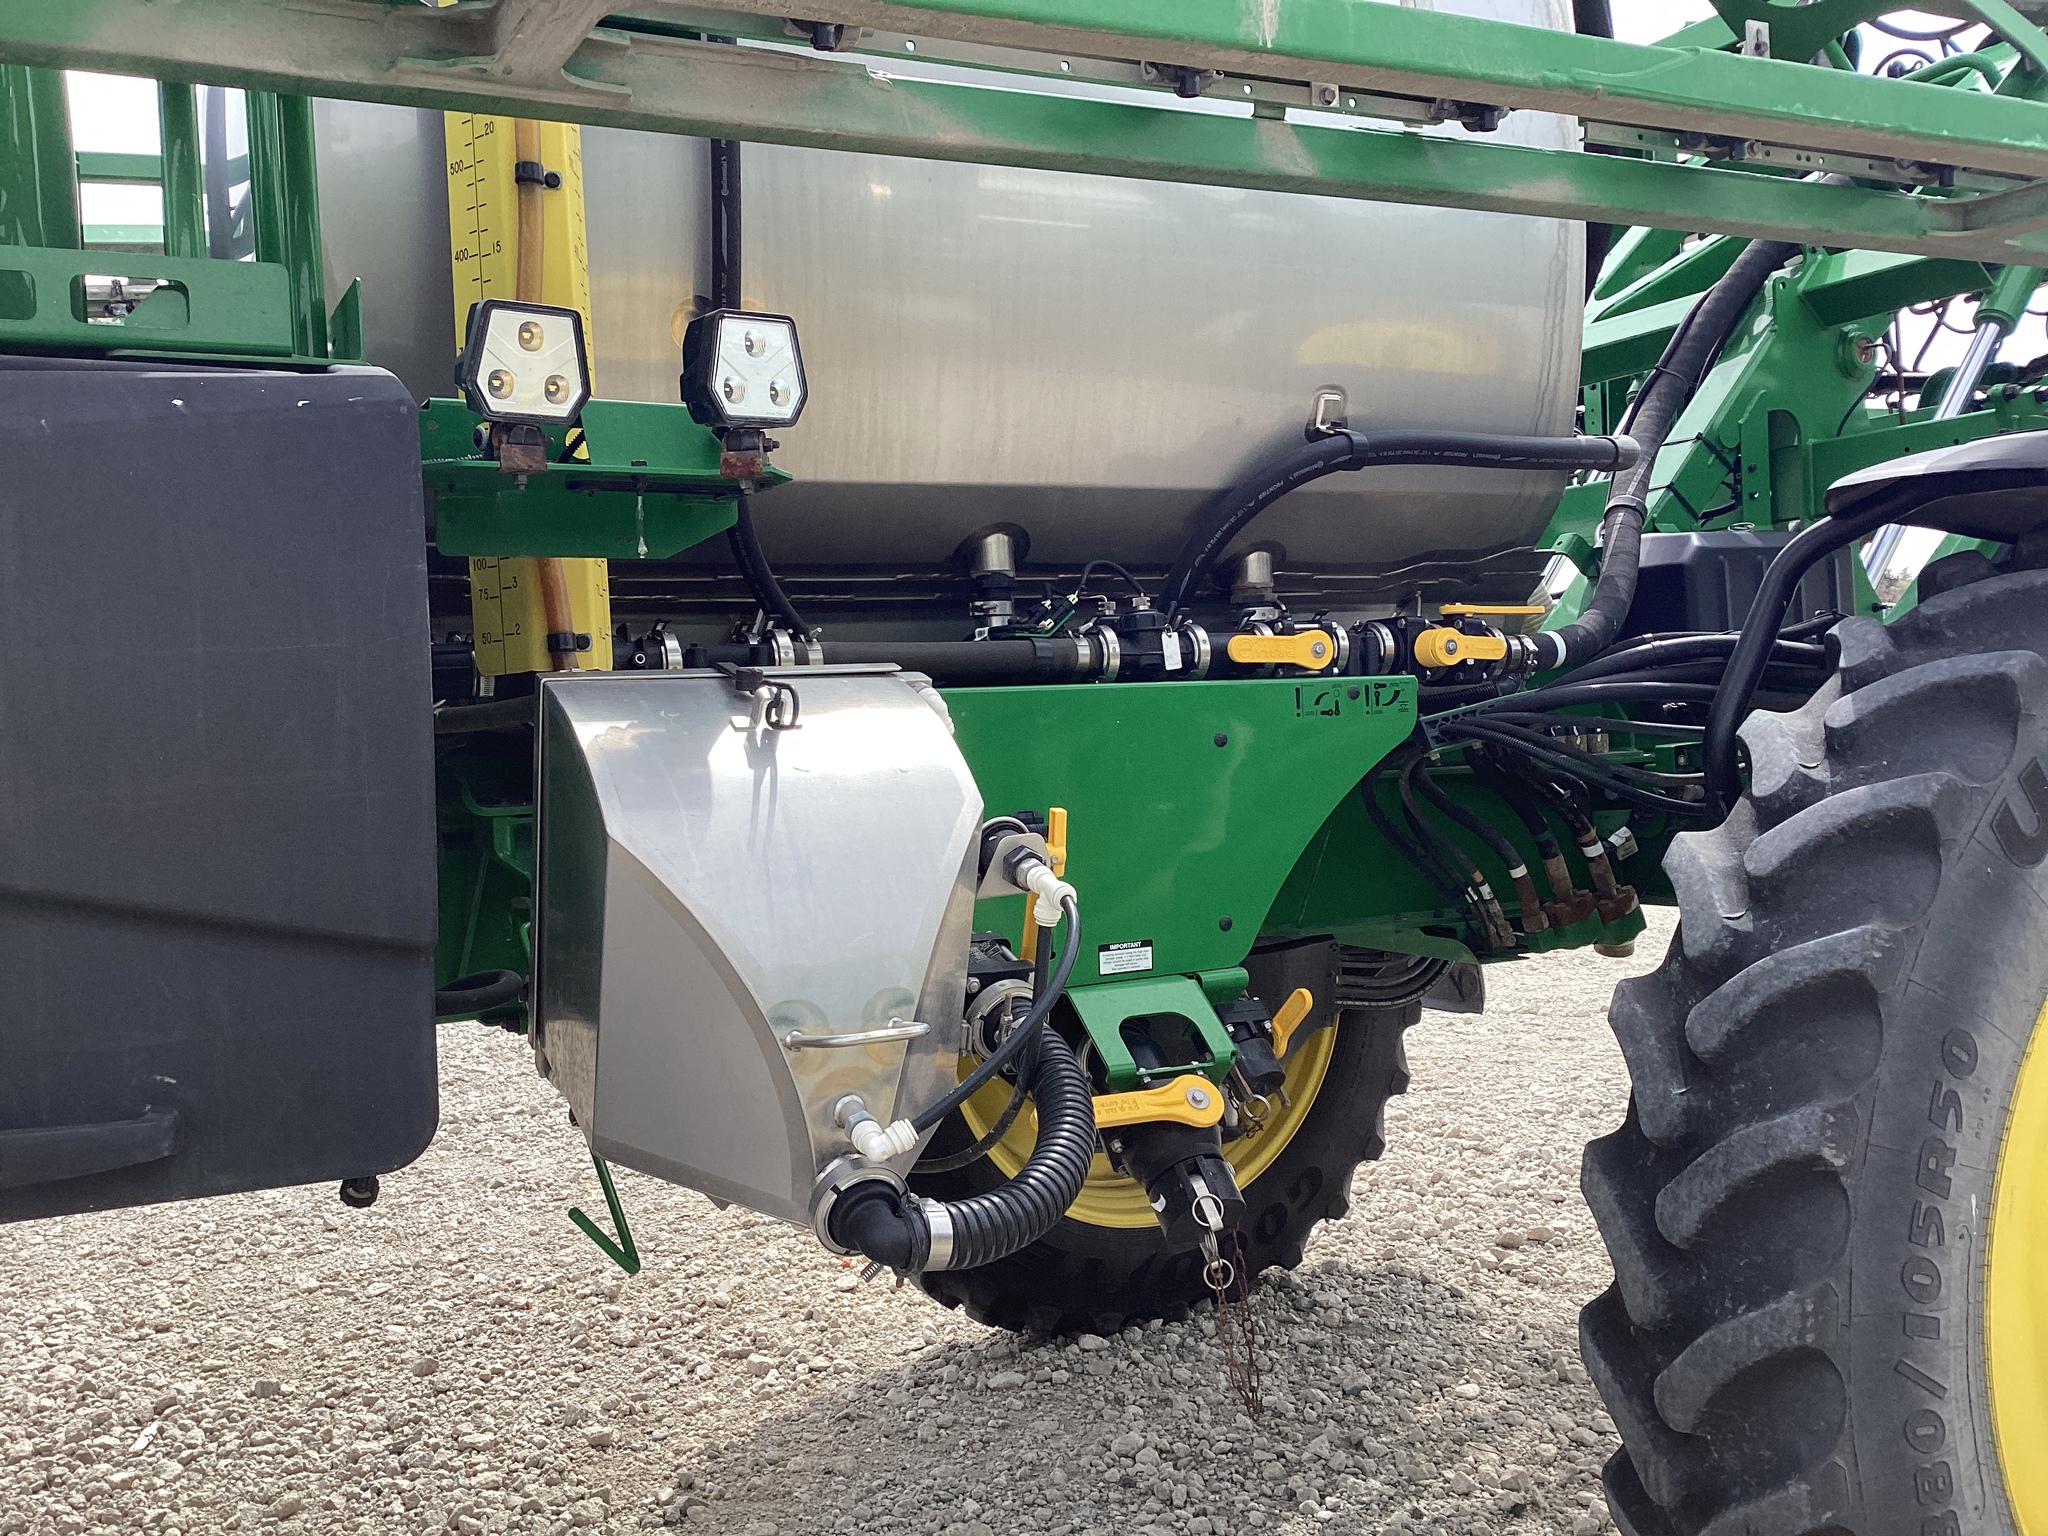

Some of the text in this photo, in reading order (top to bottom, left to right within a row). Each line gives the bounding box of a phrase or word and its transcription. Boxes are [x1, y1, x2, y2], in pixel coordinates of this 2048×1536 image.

[484, 120, 495, 136] 20
[450, 159, 464, 176] 500
[492, 240, 502, 255] 15
[454, 248, 469, 263] 400
[473, 557, 487, 572] 100
[512, 576, 518, 589] 3
[478, 588, 489, 601] 75
[514, 622, 521, 636] 2
[481, 631, 492, 645] 50
[1109, 941, 1142, 951] IMPORTANT
